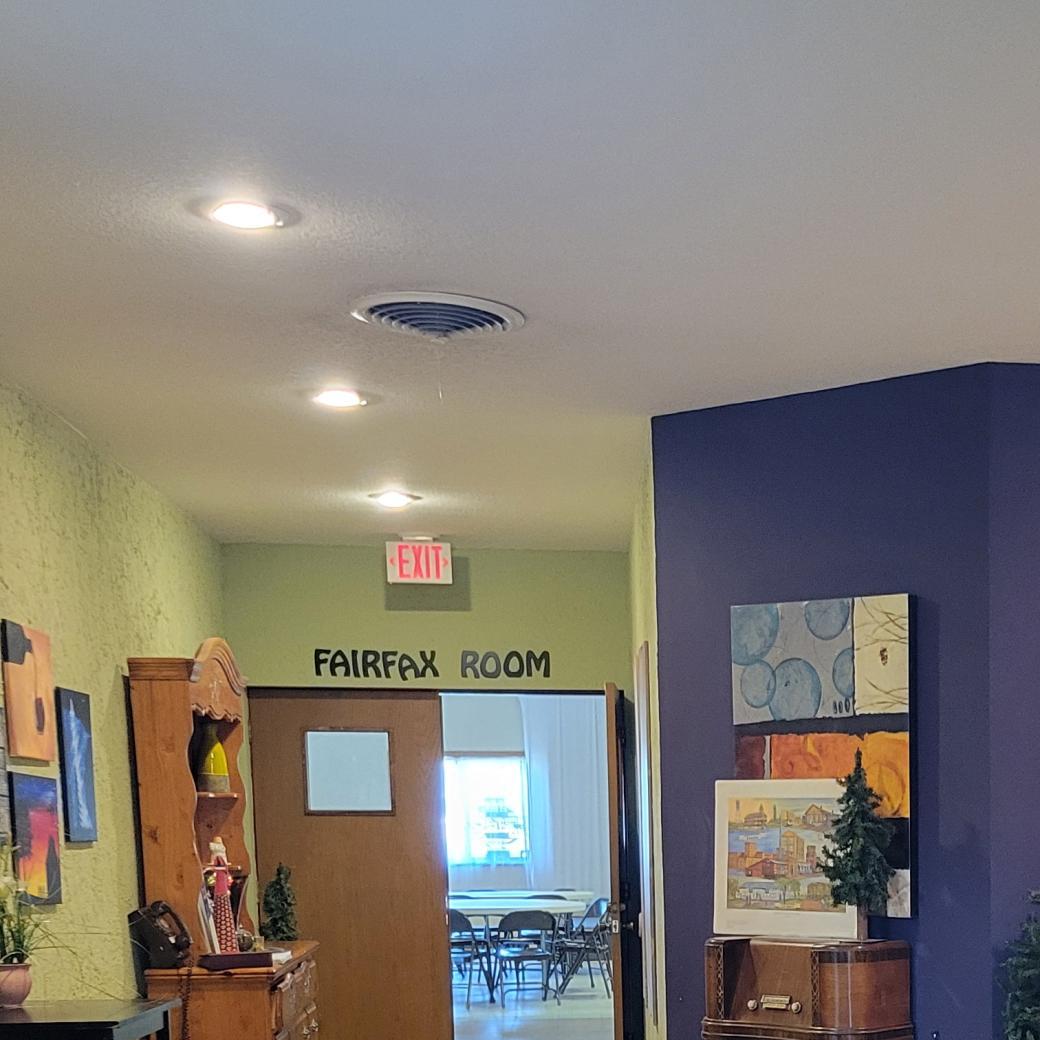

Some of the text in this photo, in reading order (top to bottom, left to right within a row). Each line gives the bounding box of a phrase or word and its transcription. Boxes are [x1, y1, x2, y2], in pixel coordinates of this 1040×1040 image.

[397, 544, 442, 579] EXIT
[314, 648, 551, 681] FAIRFAX ROOM
